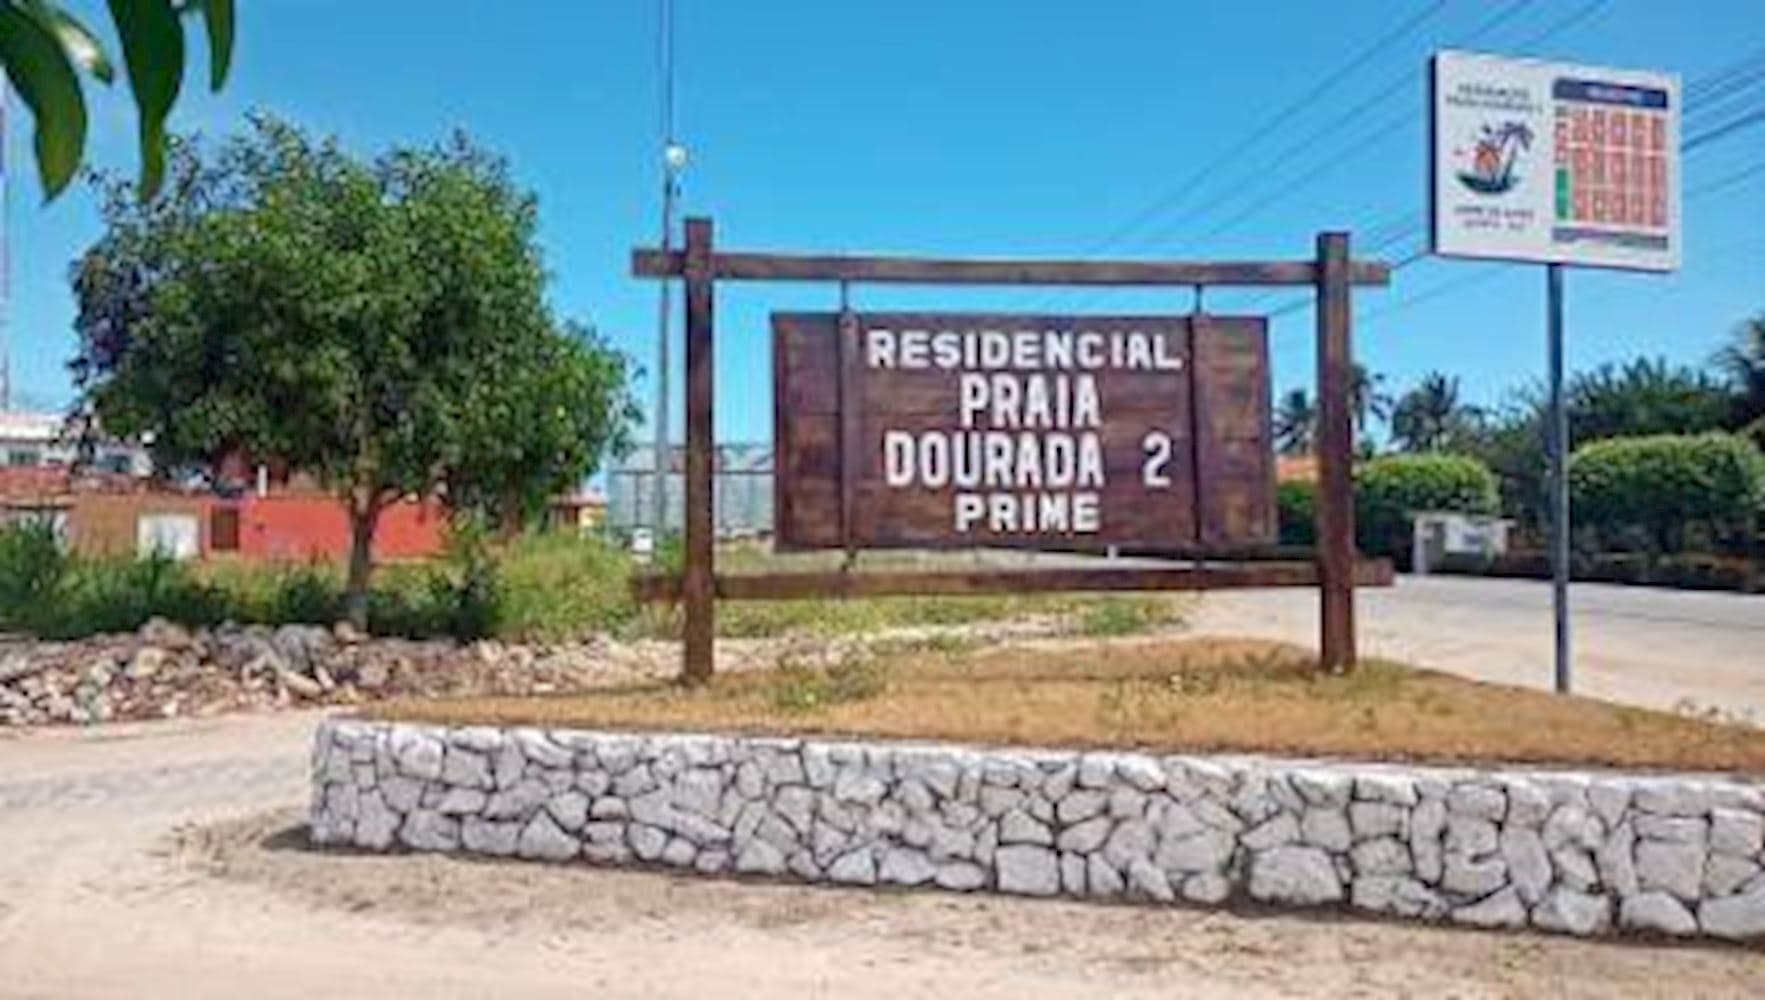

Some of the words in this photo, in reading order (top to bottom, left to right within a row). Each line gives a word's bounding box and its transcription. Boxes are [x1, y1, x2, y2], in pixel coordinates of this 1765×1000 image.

[867, 331, 1182, 369] RESIDENCIAL
[960, 374, 1101, 428] PRAIA
[884, 432, 1105, 487] DOURADA
[1142, 436, 1171, 486] 2
[955, 495, 1100, 533] PRIME
